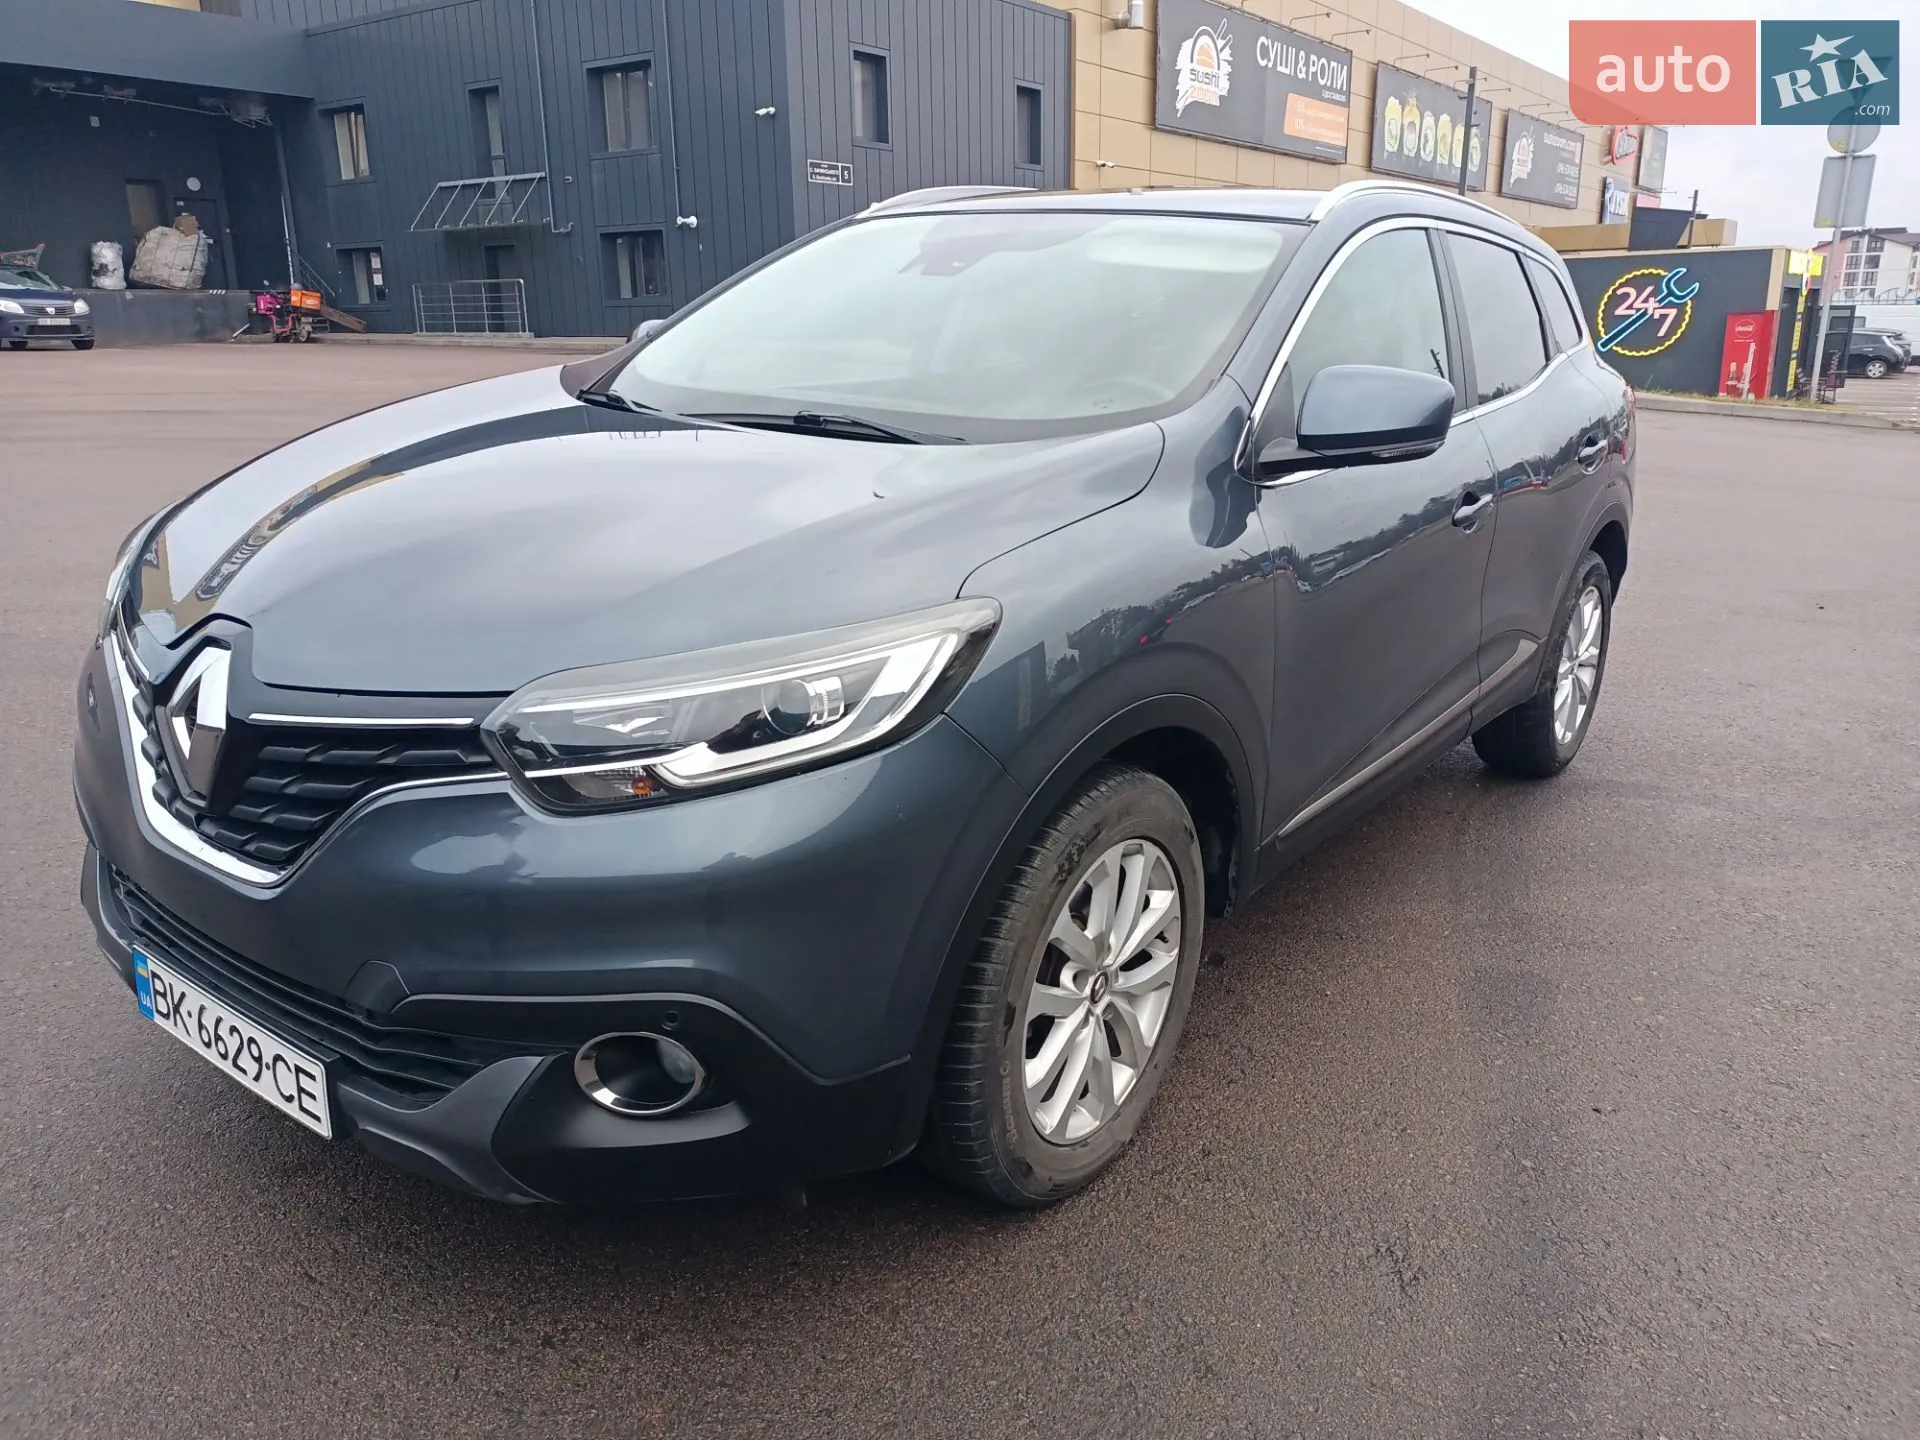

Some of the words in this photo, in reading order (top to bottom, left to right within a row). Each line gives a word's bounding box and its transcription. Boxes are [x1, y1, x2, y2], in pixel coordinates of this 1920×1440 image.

[1256, 36, 1296, 76] СУШІ
[1297, 50, 1307, 80] &
[1308, 54, 1347, 92] РОЛИ
[843, 170, 849, 180] 5
[1614, 286, 1660, 316] 24
[1653, 308, 1678, 337] 7
[140, 991, 153, 1010] UA
[197, 1003, 264, 1083] 6629
